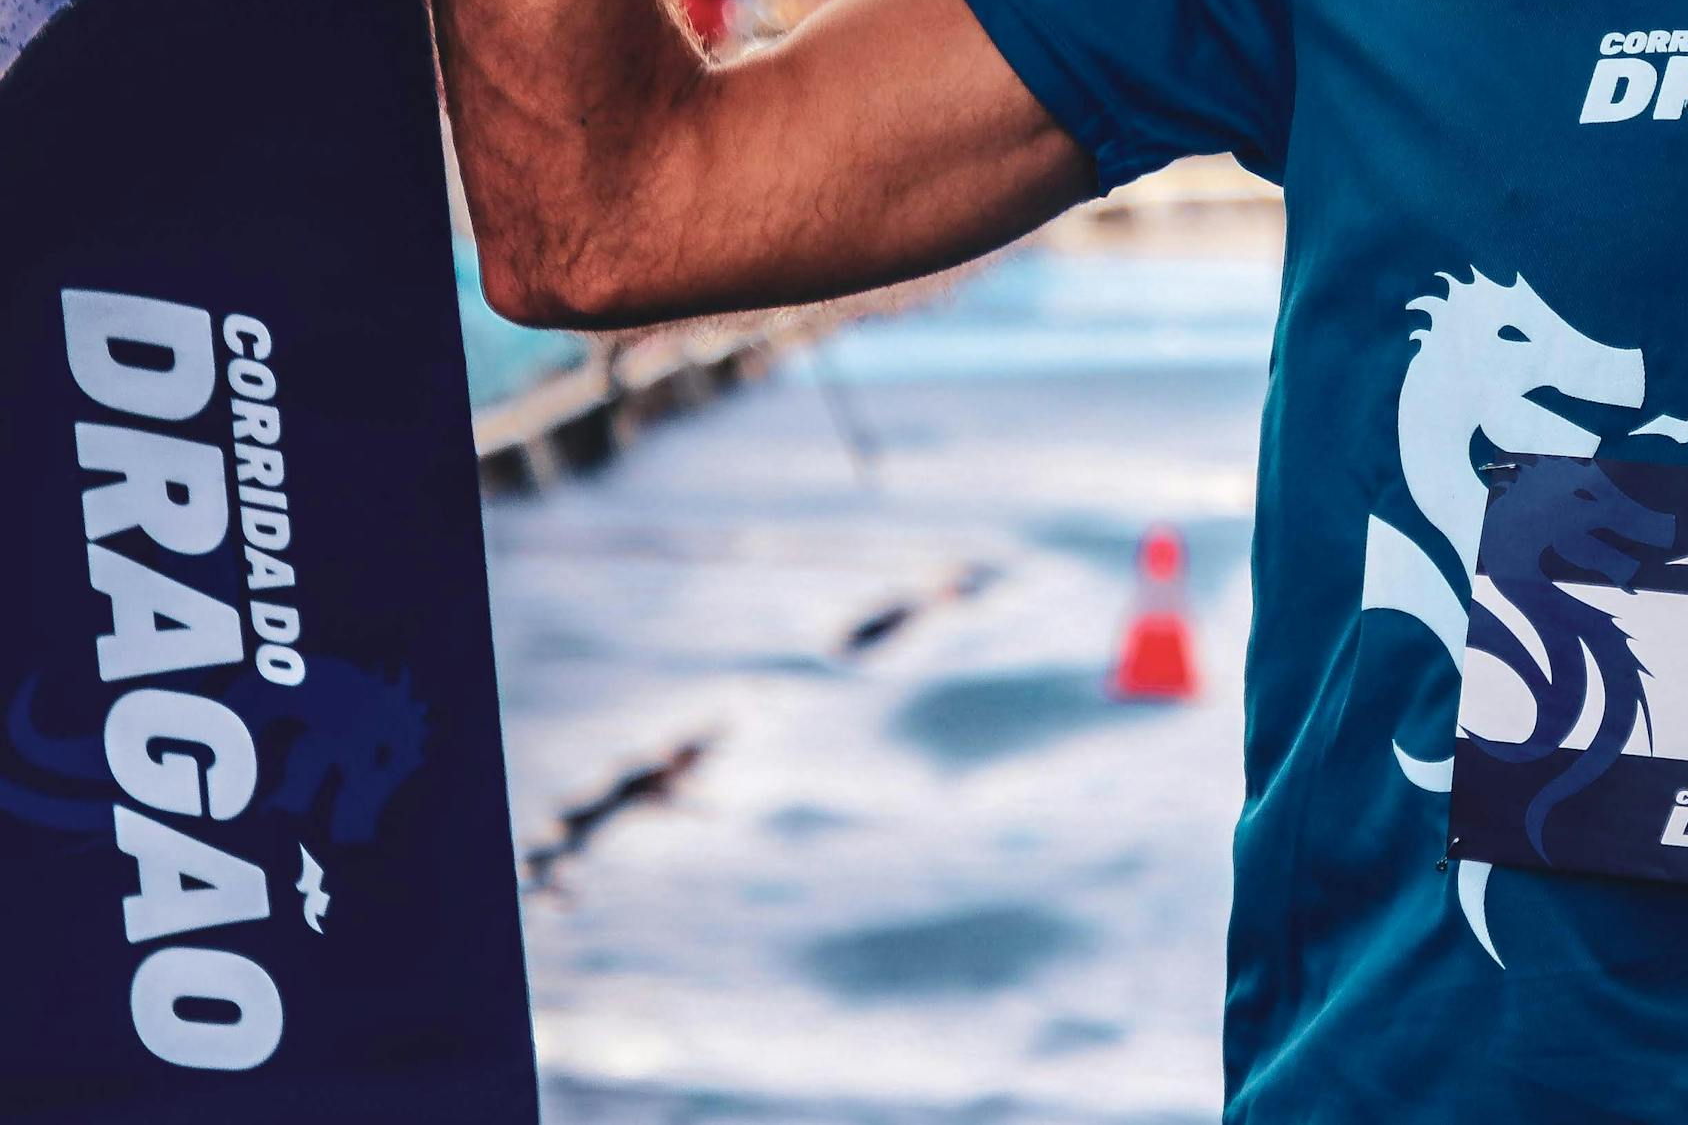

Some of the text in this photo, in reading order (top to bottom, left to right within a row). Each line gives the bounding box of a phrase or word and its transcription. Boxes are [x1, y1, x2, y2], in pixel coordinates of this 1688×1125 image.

[60, 288, 331, 1072] DRAGÃO
[222, 313, 306, 687] CORRIDA DO
